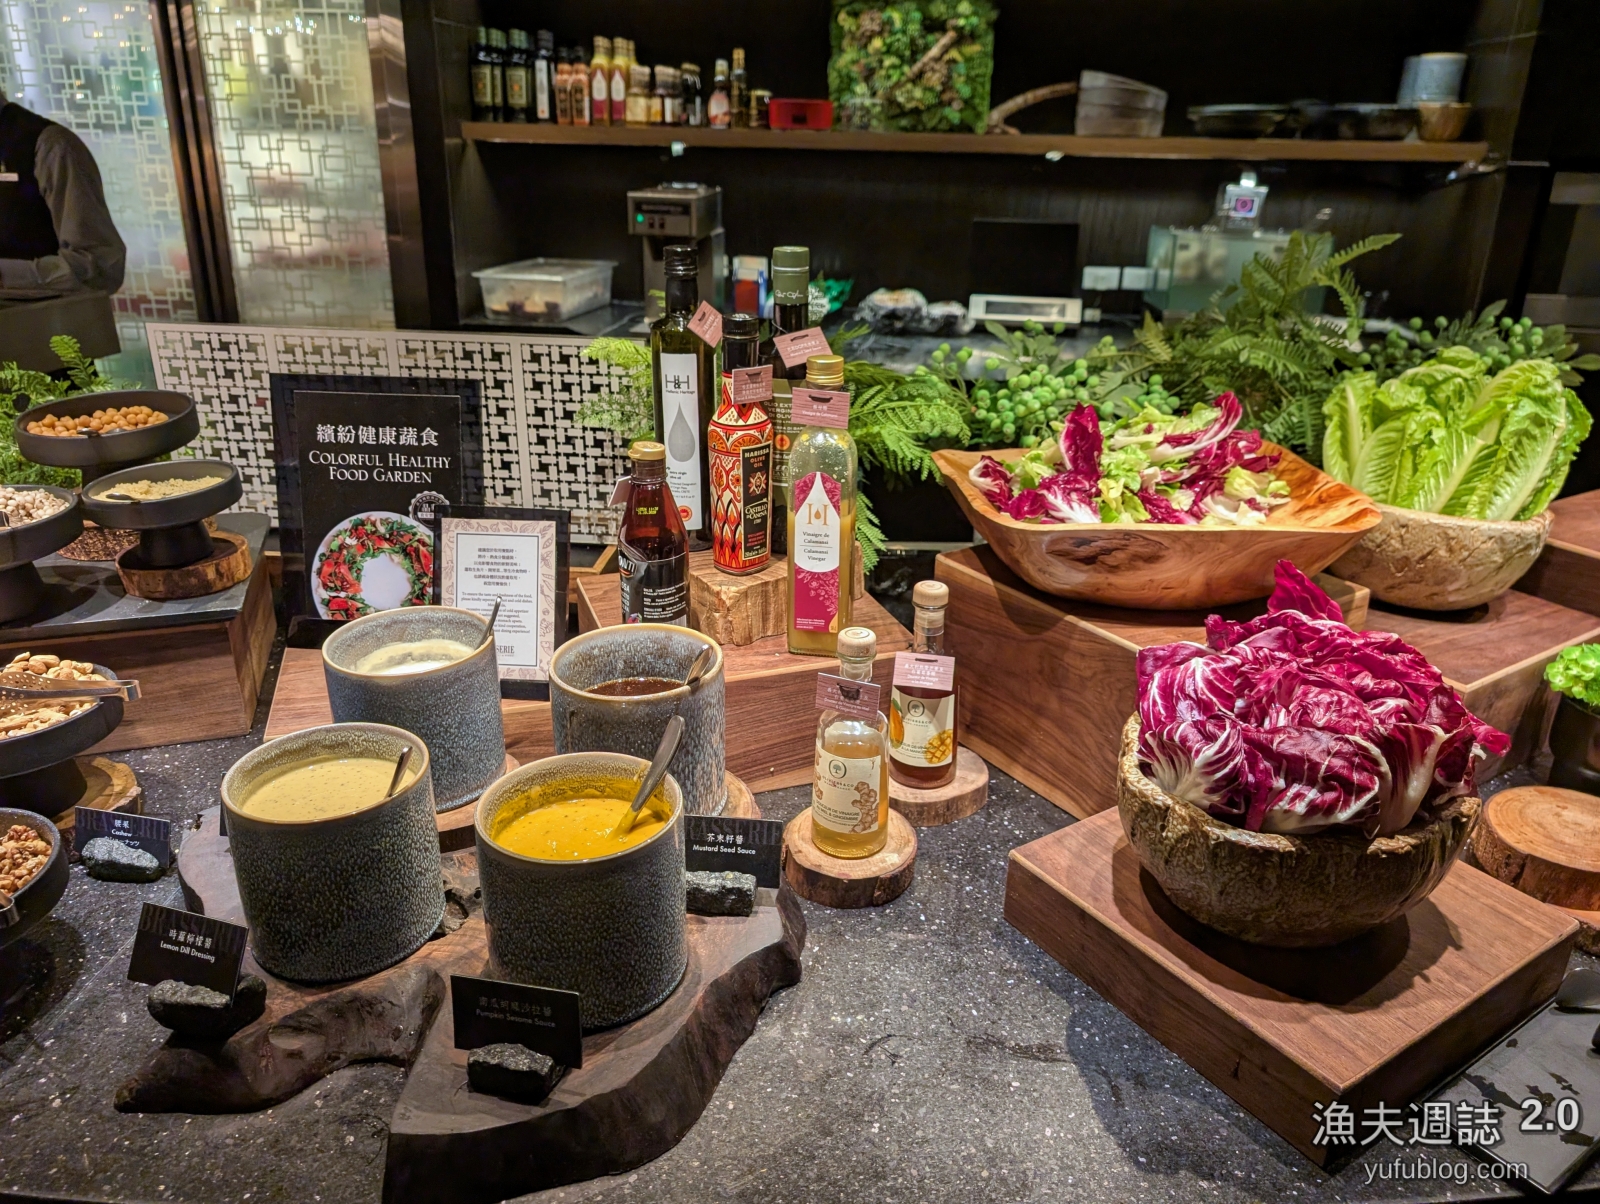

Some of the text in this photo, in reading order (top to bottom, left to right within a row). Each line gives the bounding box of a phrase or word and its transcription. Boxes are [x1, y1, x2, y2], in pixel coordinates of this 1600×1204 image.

[316, 424, 439, 446] 繽紛健康蔬食
[745, 448, 769, 458] HARISSA
[745, 504, 768, 514] CASTILLO
[618, 555, 635, 572] ONTI
[496, 645, 515, 654] SERIE
[111, 829, 132, 837] Cashew
[706, 833, 744, 845] 芥末籽醬
[692, 844, 718, 852] Mustard
[720, 846, 735, 854] Seed
[160, 940, 216, 963] Lemon Dill Dressing
[475, 1008, 556, 1028] Pumpkin Sesame Sauce
